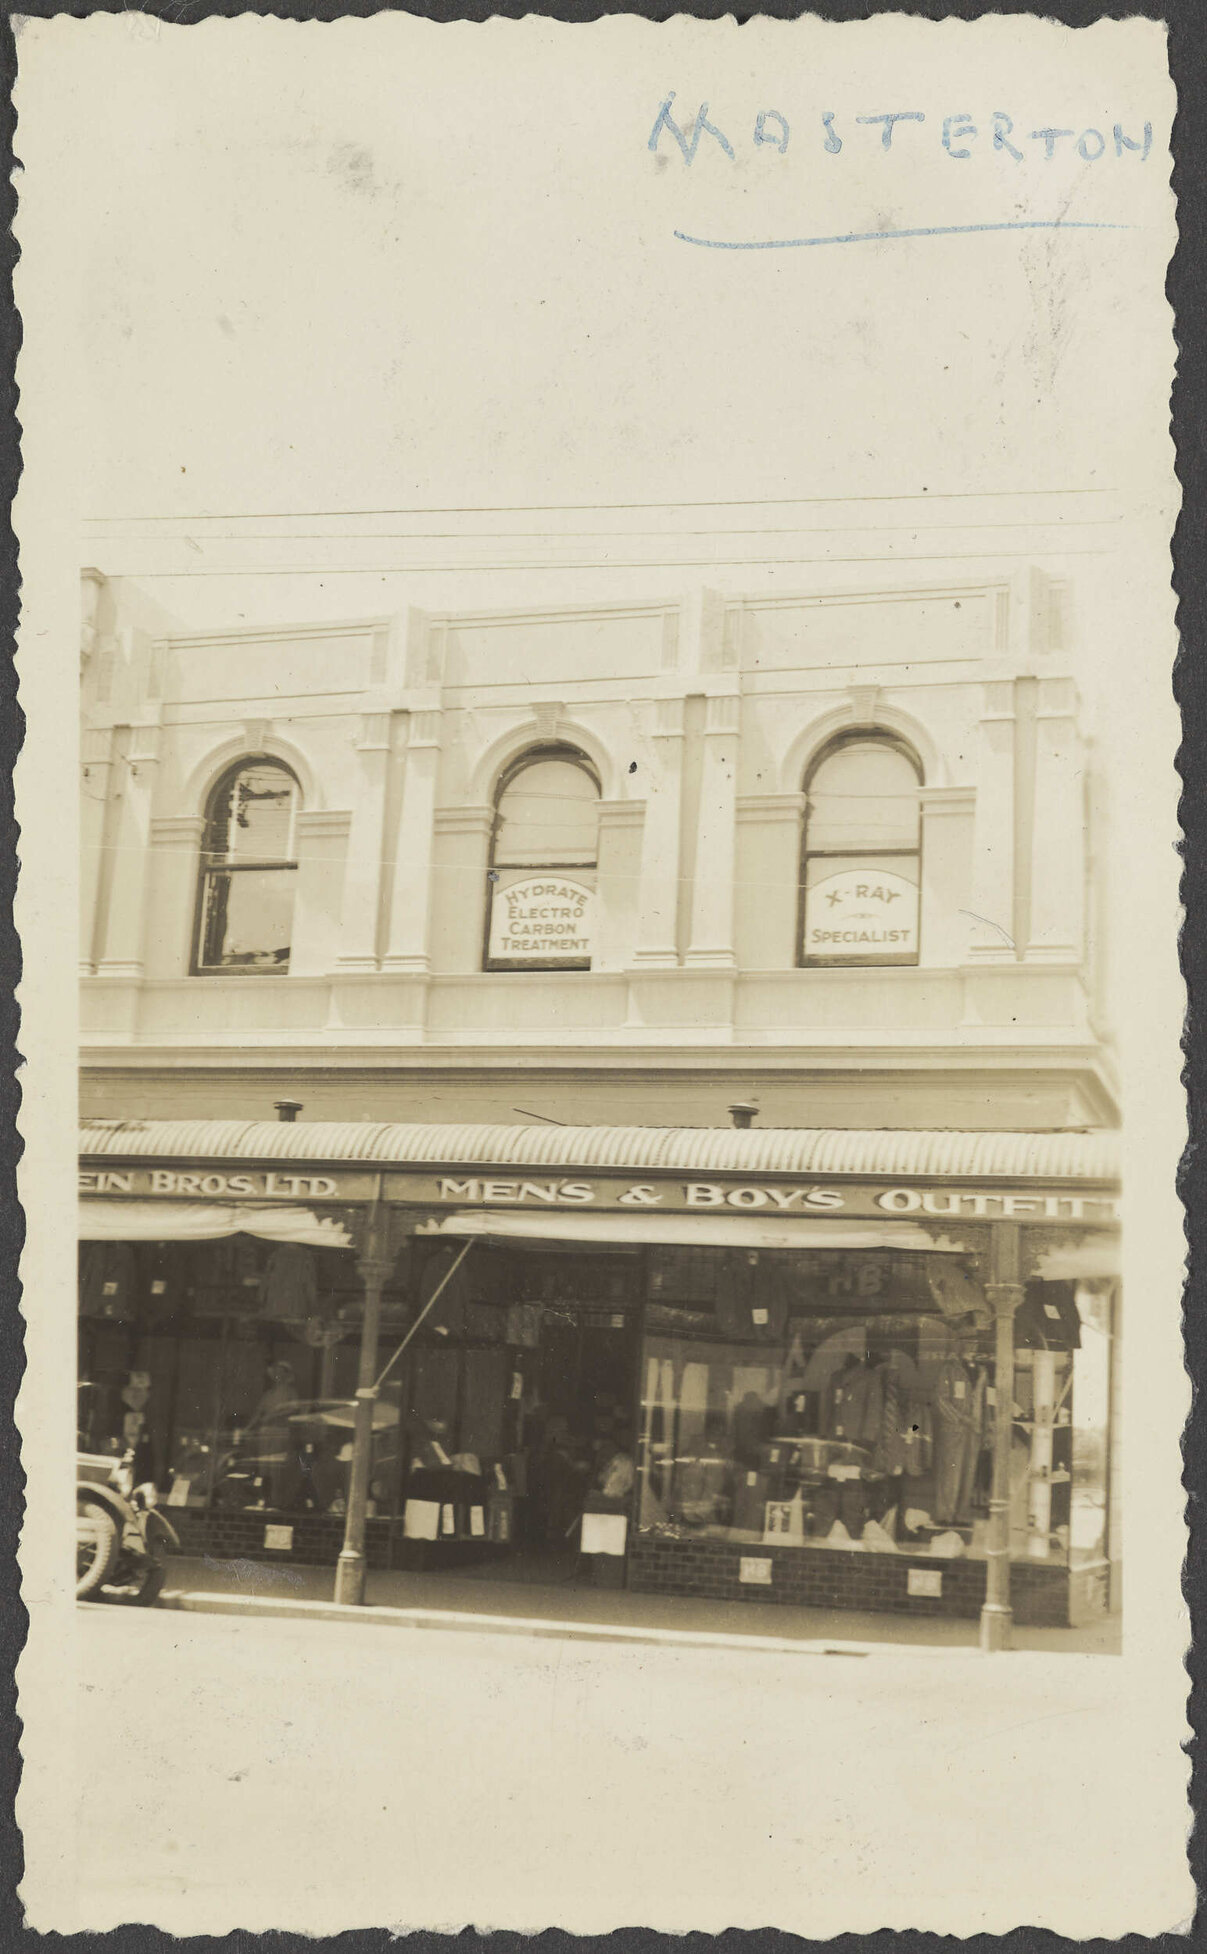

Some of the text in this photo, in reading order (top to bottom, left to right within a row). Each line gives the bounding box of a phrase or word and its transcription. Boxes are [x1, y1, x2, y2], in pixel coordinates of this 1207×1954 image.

[648, 91, 1153, 165] MASTERTON
[504, 884, 588, 906] HYDRATE
[508, 906, 584, 919] ELECTRO
[509, 921, 577, 935] CARBON
[811, 928, 911, 943] SPECIALIST
[501, 937, 590, 951] TREATMENT
[618, 1184, 664, 1205] &
